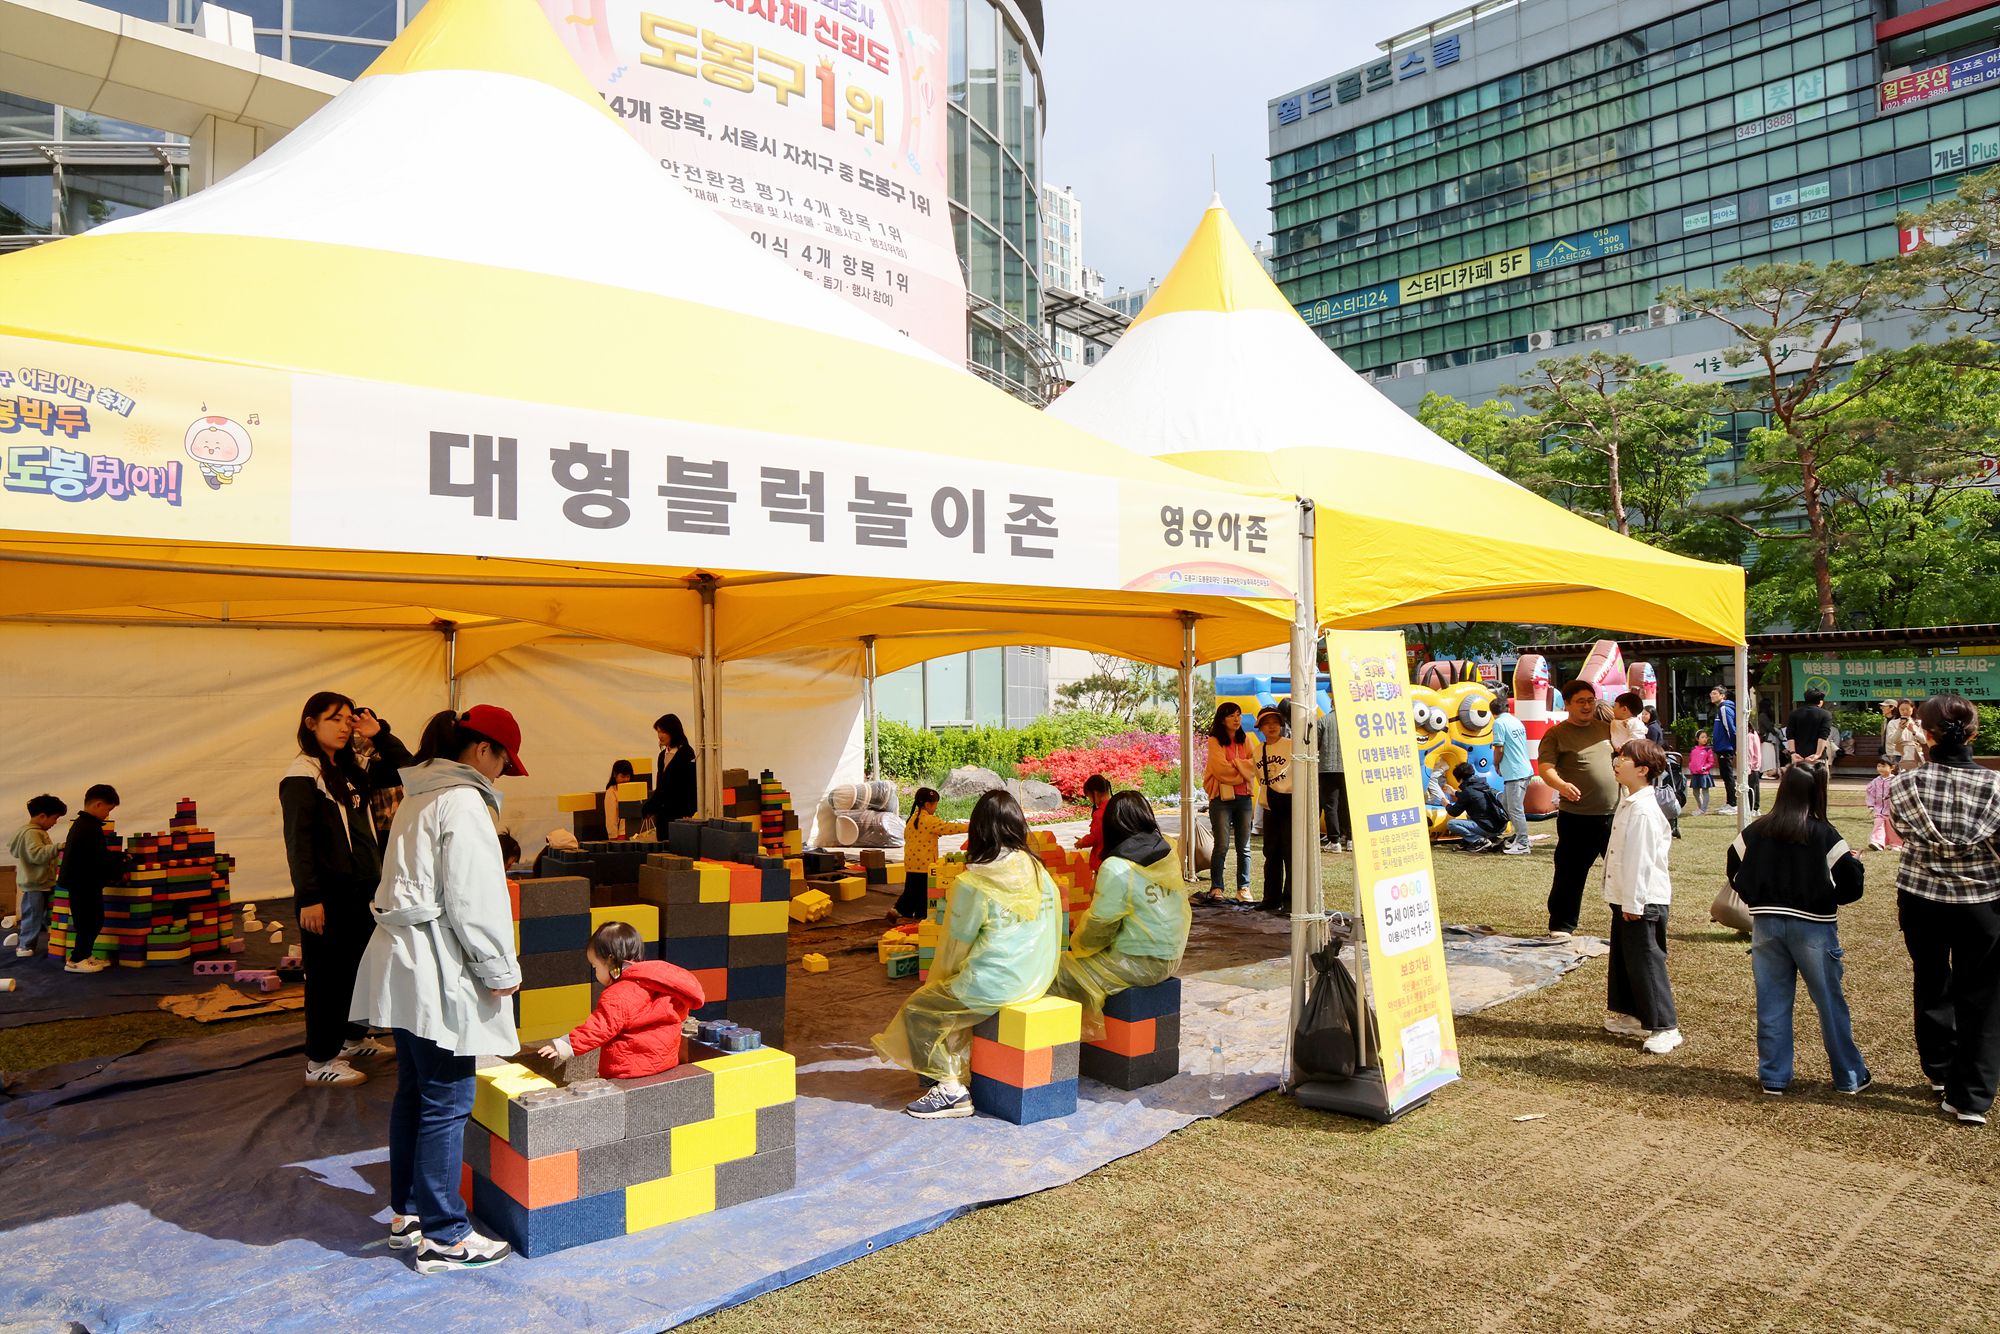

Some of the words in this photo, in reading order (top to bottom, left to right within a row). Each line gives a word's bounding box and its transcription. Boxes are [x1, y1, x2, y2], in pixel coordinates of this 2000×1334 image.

[814, 14, 889, 76] 신뢰도
[640, 11, 806, 107] 도봉구
[1951, 58, 1984, 76] 스포츠
[1987, 53, 2000, 64] 아
[1278, 34, 1461, 126] 월드골프스쿨
[1883, 68, 1948, 101] 월드풋샵
[1951, 72, 1984, 90] 발관리
[1737, 121, 1763, 138] 3491
[1767, 113, 1793, 130] 3888
[598, 91, 651, 124] 4개
[659, 106, 713, 141] 항목,
[720, 125, 776, 157] 서울시
[783, 142, 834, 175] 자치구
[838, 161, 854, 183] 중
[858, 168, 906, 203] 도봉구
[909, 189, 931, 217] 1위
[1934, 146, 1964, 171] 개념
[1972, 142, 1998, 162] Plus
[1800, 185, 1828, 197] 바이올린
[755, 182, 794, 207] 평가
[803, 197, 831, 218] 4개
[838, 207, 871, 232] 항목
[878, 222, 903, 243] 1위
[1712, 206, 1737, 220] 피아노
[1773, 215, 1797, 230] 6232
[1593, 227, 1609, 238] 010
[1598, 234, 1620, 246] 3300
[1604, 243, 1625, 254] 3153
[801, 244, 831, 270] 4개
[842, 254, 875, 282] 항목
[885, 269, 909, 294] 1위
[1407, 260, 1493, 297] 스터디카페
[1500, 253, 1523, 274] 5F
[823, 275, 843, 292] 돕기
[851, 283, 871, 300] 행사
[873, 289, 894, 307] 참여)
[1299, 289, 1389, 322] 크앤스터디24
[18, 367, 95, 403] 어린이날
[96, 387, 136, 418] 축제
[1160, 505, 1268, 554] 영유아존
[1802, 662, 1840, 675] 애완동물
[1845, 662, 1874, 675] 외출시
[1876, 660, 1916, 674] 배설물은
[1918, 660, 1932, 673] 꼭!
[1840, 688, 1868, 698] 위반시
[1871, 688, 1902, 697] 10만원
[1906, 688, 1926, 697] 이하
[1964, 687, 1991, 696] 부과!
[1906, 677, 1926, 687] 수거
[1929, 677, 1950, 686] 규정
[1954, 676, 1979, 685] 준수!
[1354, 711, 1407, 739] 영유아존
[1384, 906, 1402, 927] 5세
[1402, 904, 1416, 920] 이하
[1387, 928, 1410, 943] 이용시간
[1400, 955, 1432, 977] 보호자님!
